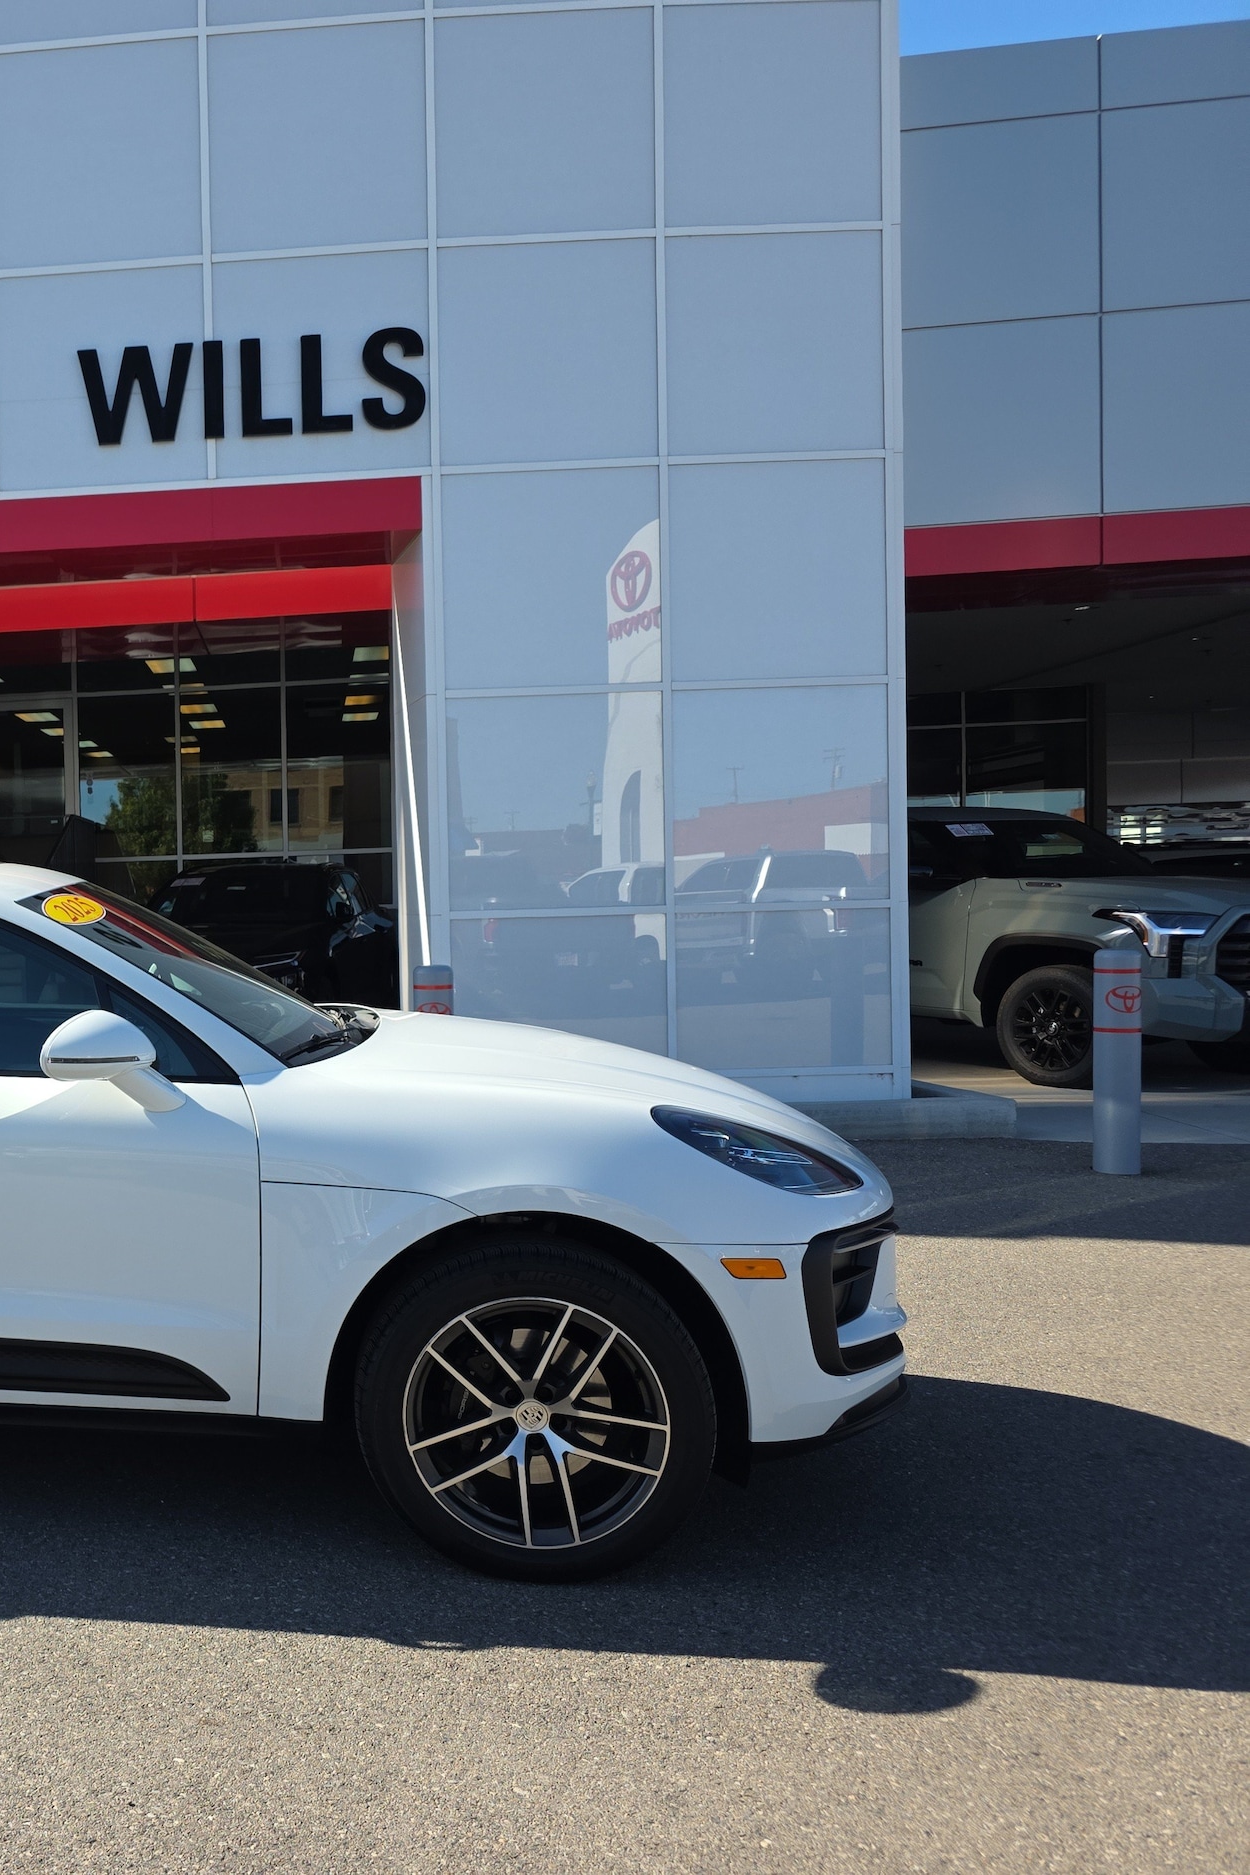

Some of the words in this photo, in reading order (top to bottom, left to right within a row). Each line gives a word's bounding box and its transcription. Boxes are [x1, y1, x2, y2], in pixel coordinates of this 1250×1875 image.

[77, 327, 426, 446] WILLS
[53, 897, 97, 922] 2025
[517, 1271, 615, 1301] MICHELIN
